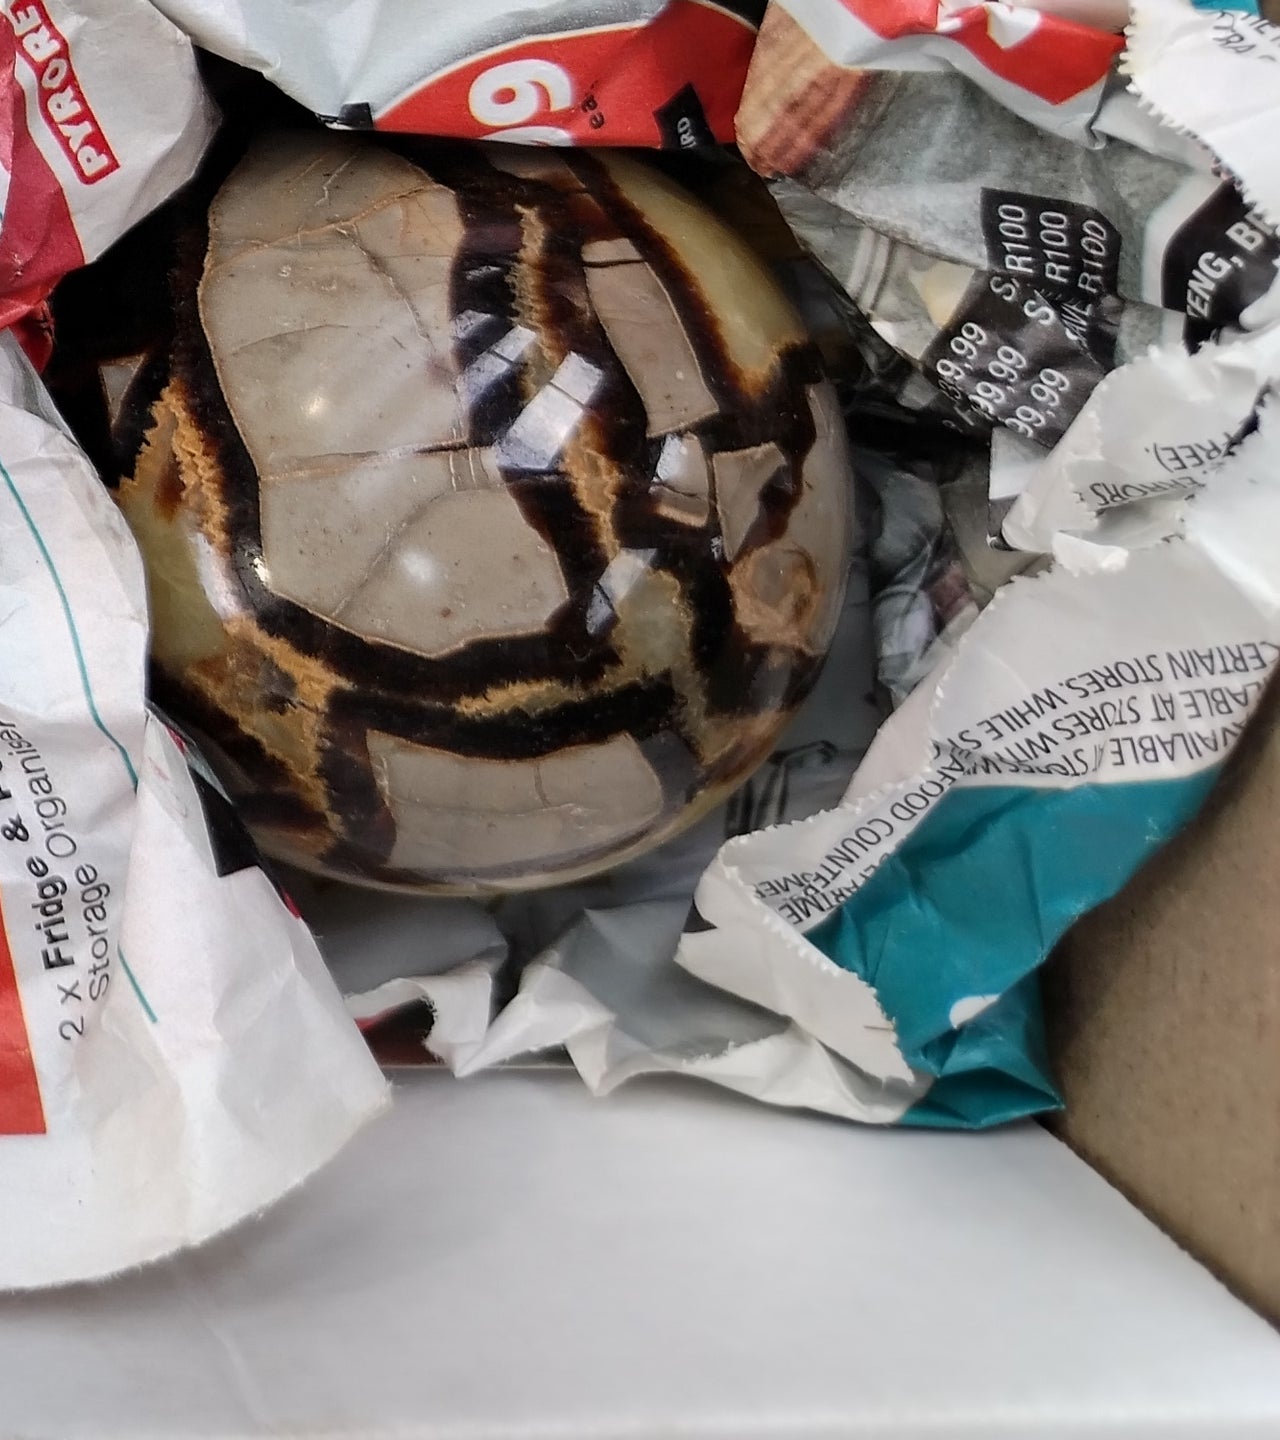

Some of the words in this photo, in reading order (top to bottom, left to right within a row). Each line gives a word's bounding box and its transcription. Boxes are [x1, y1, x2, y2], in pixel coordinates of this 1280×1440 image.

[997, 202, 1035, 274] R100
[1038, 209, 1072, 284] R100
[1076, 218, 1110, 294] R100
[1057, 652, 1163, 699] STORES.
[979, 685, 1056, 735] WHILE
[1058, 696, 1143, 739] STORES
[1149, 693, 1178, 722] AT
[0, 815, 31, 845] &
[30, 857, 76, 972] Fridge
[75, 862, 112, 1002] Storage
[57, 980, 83, 1007] x
[58, 1014, 85, 1042] 2
